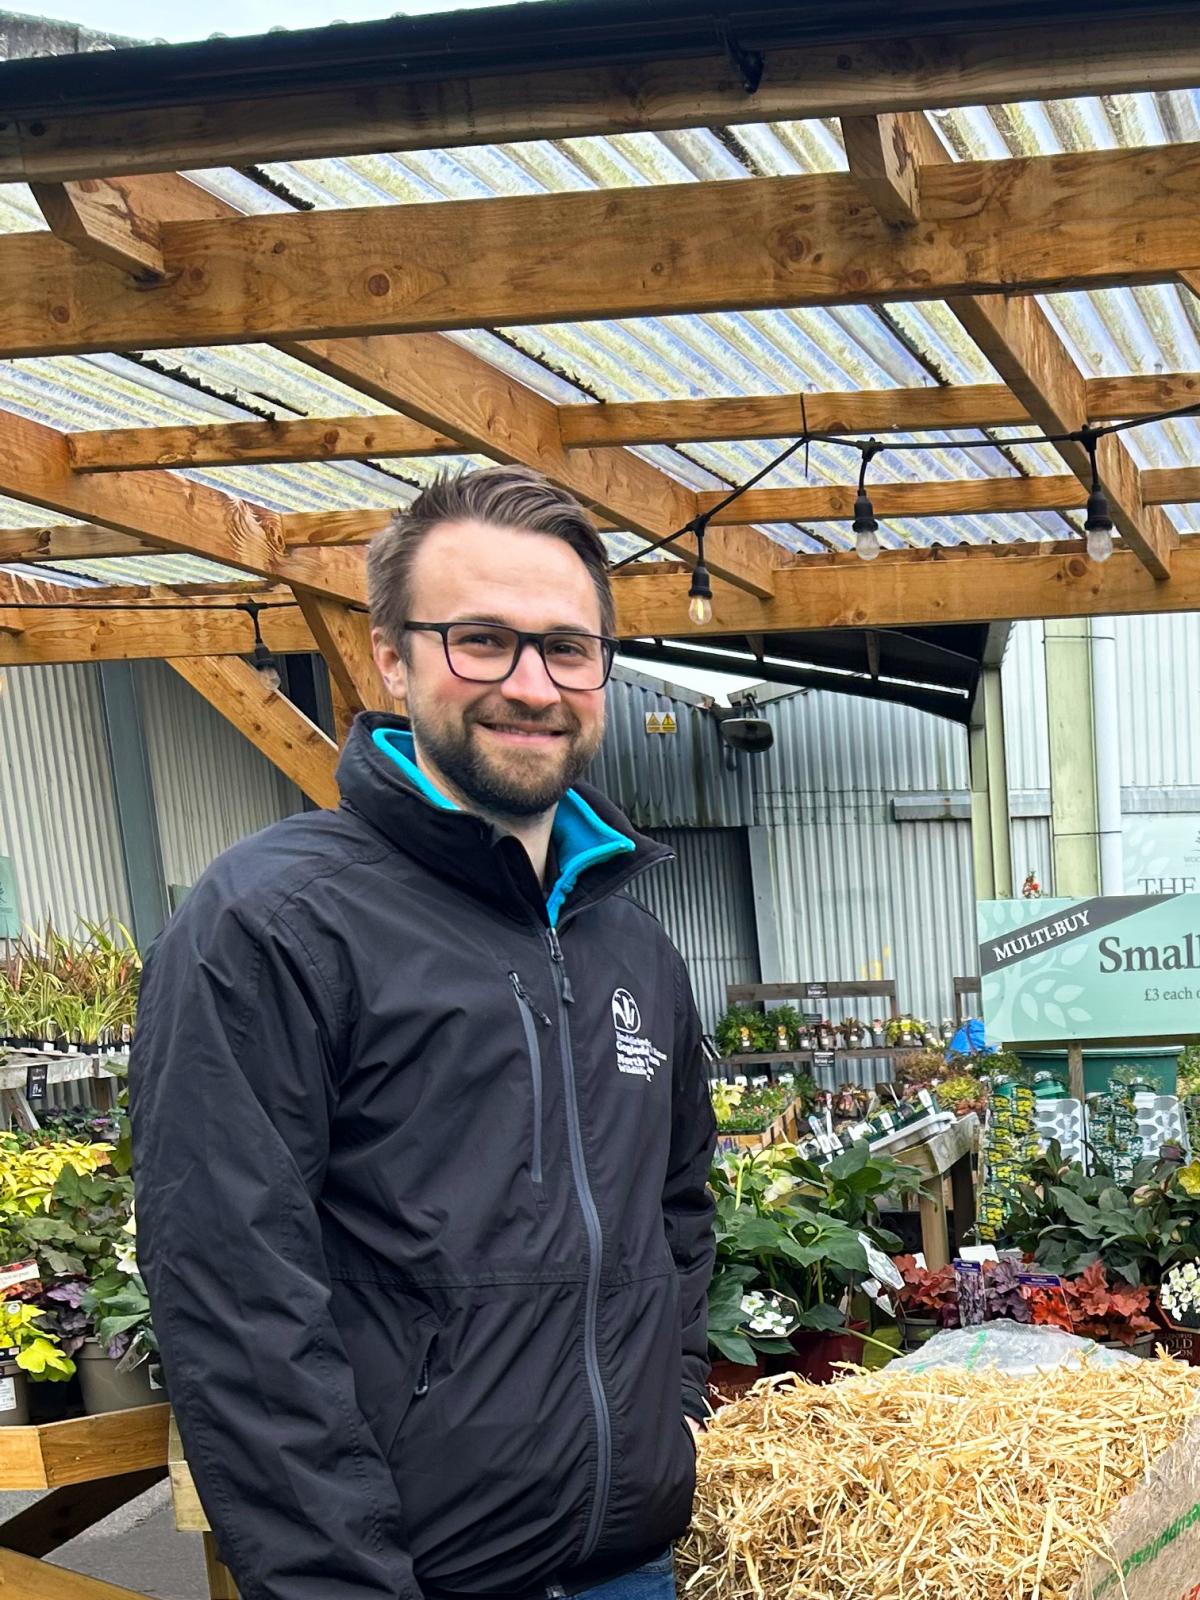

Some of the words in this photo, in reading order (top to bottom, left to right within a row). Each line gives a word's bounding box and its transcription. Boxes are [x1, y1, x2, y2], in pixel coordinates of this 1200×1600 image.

[993, 910, 1090, 962] MULTI-BUY
[1144, 987, 1160, 1001] £3
[1163, 986, 1193, 1000] each
